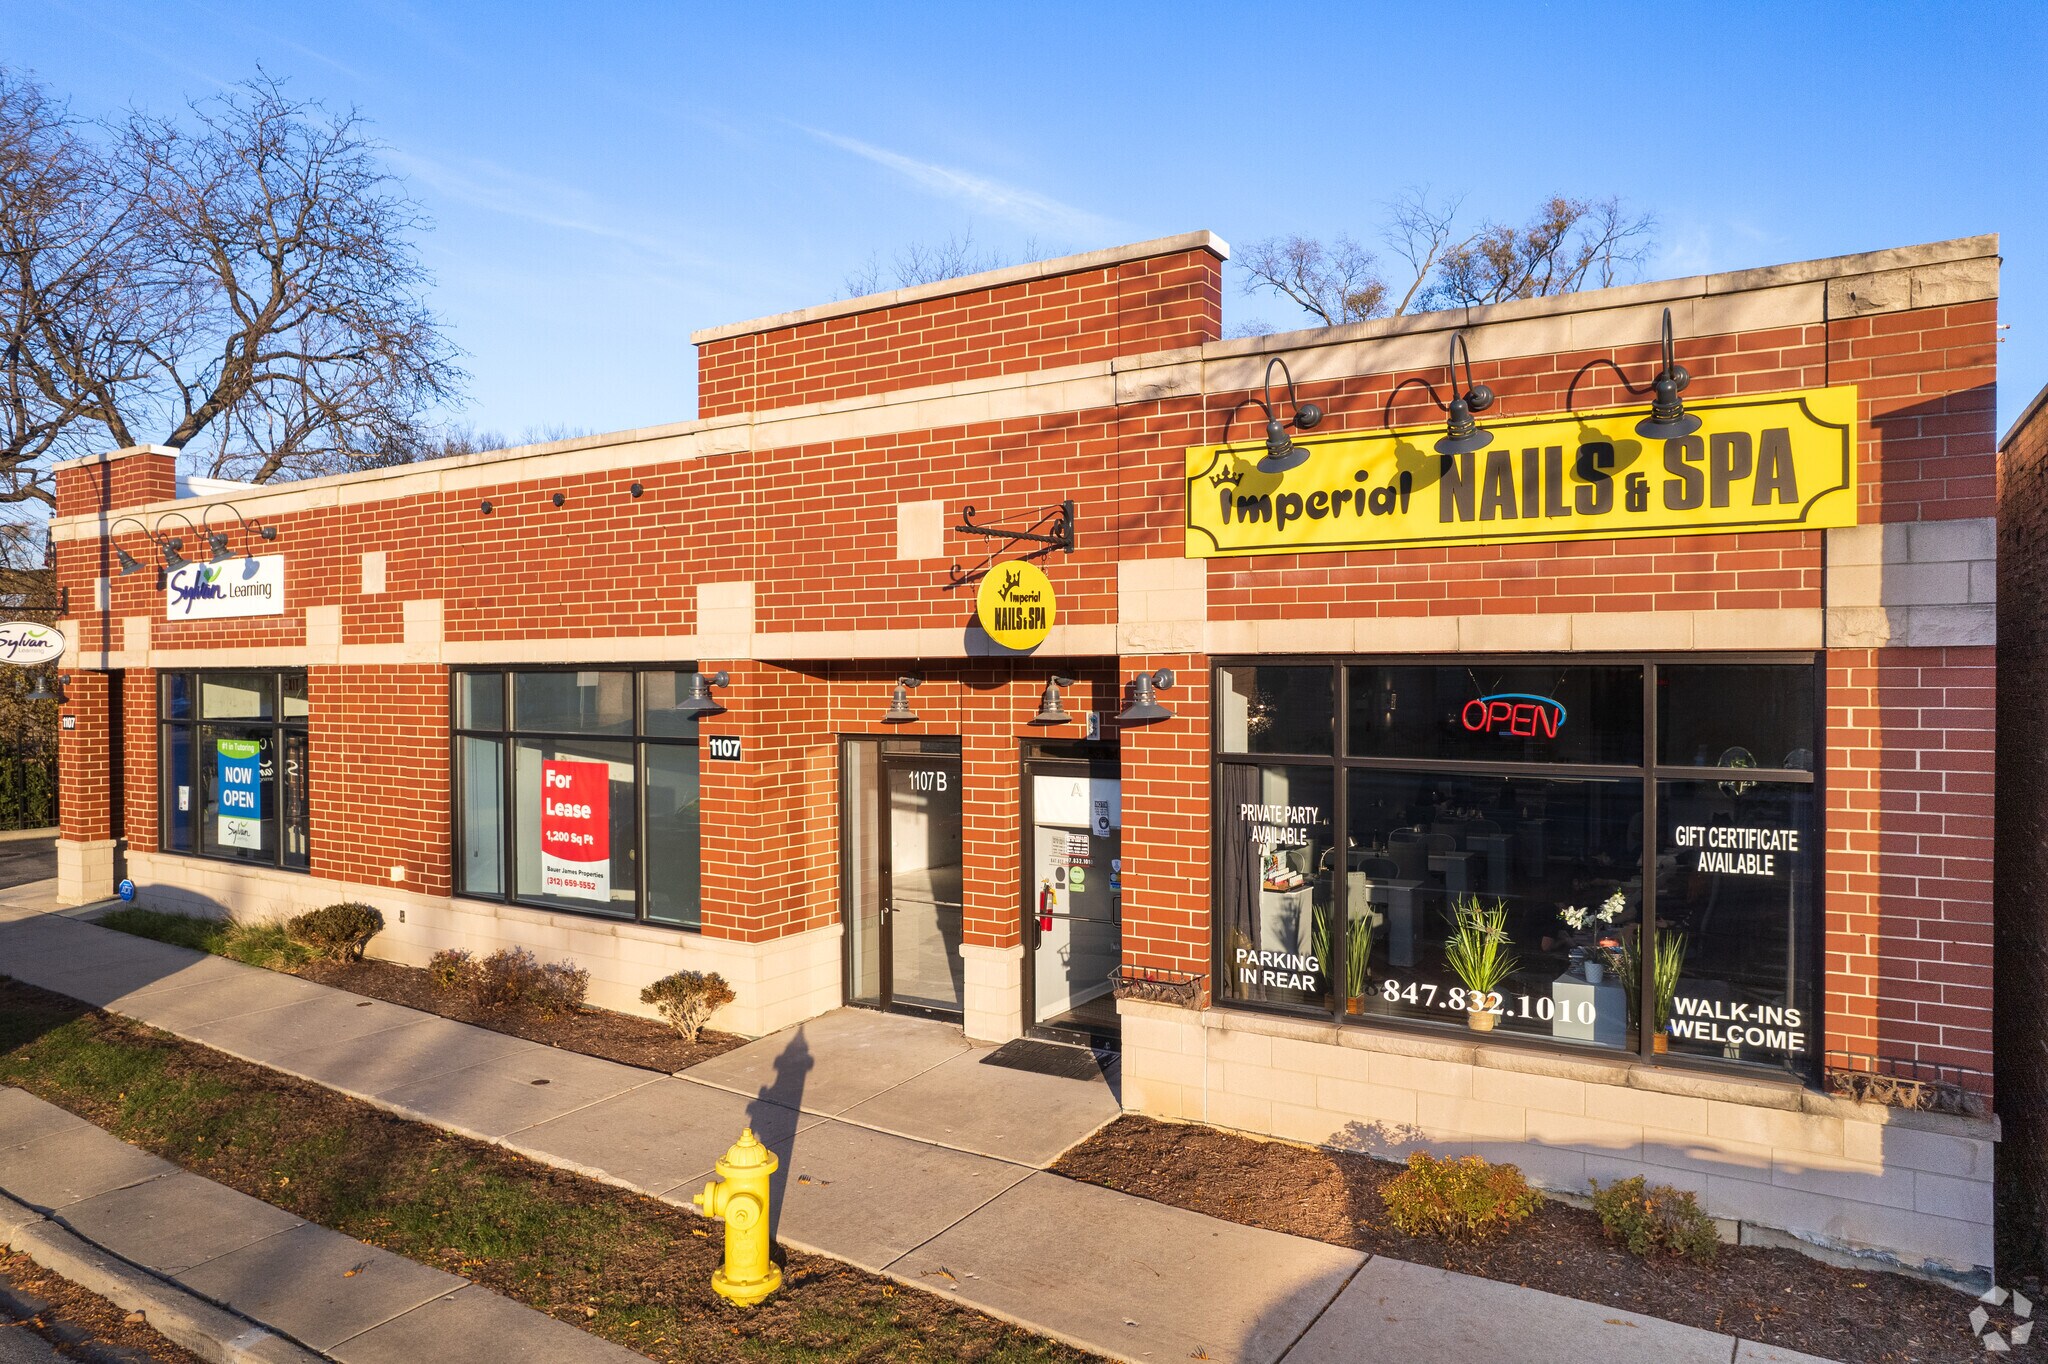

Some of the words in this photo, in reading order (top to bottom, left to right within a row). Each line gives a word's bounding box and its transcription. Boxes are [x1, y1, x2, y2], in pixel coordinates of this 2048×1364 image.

[1219, 469, 1413, 532] Imperial
[1439, 442, 1614, 523] NAILS
[1625, 471, 1651, 513] &
[1663, 428, 1800, 511] SPA
[170, 569, 227, 614] Sylvan
[229, 581, 272, 599] Learning
[1009, 590, 1041, 605] Imperial
[994, 606, 1023, 631] NAILS
[1028, 606, 1046, 630] SPA
[0, 630, 54, 659] Sylvan
[62, 717, 76, 729] 1107
[1461, 699, 1560, 739] OPEN
[221, 742, 228, 751] #1
[228, 742, 234, 751] in
[234, 743, 255, 753] Tutoring
[709, 738, 741, 757] 1107
[225, 766, 252, 785] NOW
[545, 769, 573, 789] For
[908, 770, 935, 791] 1107
[936, 771, 948, 792] B
[223, 789, 254, 809] OPEN
[1070, 782, 1082, 798] A
[546, 797, 592, 820] Lease
[1240, 803, 1282, 823] PRIVATE
[1284, 805, 1319, 825] PARTY
[227, 821, 251, 845] Sylvan
[545, 830, 570, 843] 1,200
[570, 832, 583, 847] Sq
[583, 834, 594, 846] Ft
[1251, 825, 1307, 846] AVAILABLE
[1675, 825, 1706, 847] GIFT
[1708, 826, 1799, 852] CERTIFICATE
[546, 865, 561, 873] Bauer
[561, 867, 578, 875] James
[578, 869, 604, 879] Properties
[1697, 851, 1775, 876] AVAILABLE
[546, 876, 563, 887] (312)
[564, 878, 596, 891] 659-5552
[1236, 948, 1320, 972] PARKING
[1240, 967, 1257, 985] IN
[1263, 970, 1316, 992] REAR
[1382, 979, 1597, 1025] 847.832.1010
[1673, 996, 1802, 1028] WALK-INS
[1670, 1018, 1806, 1052] WELCOME
